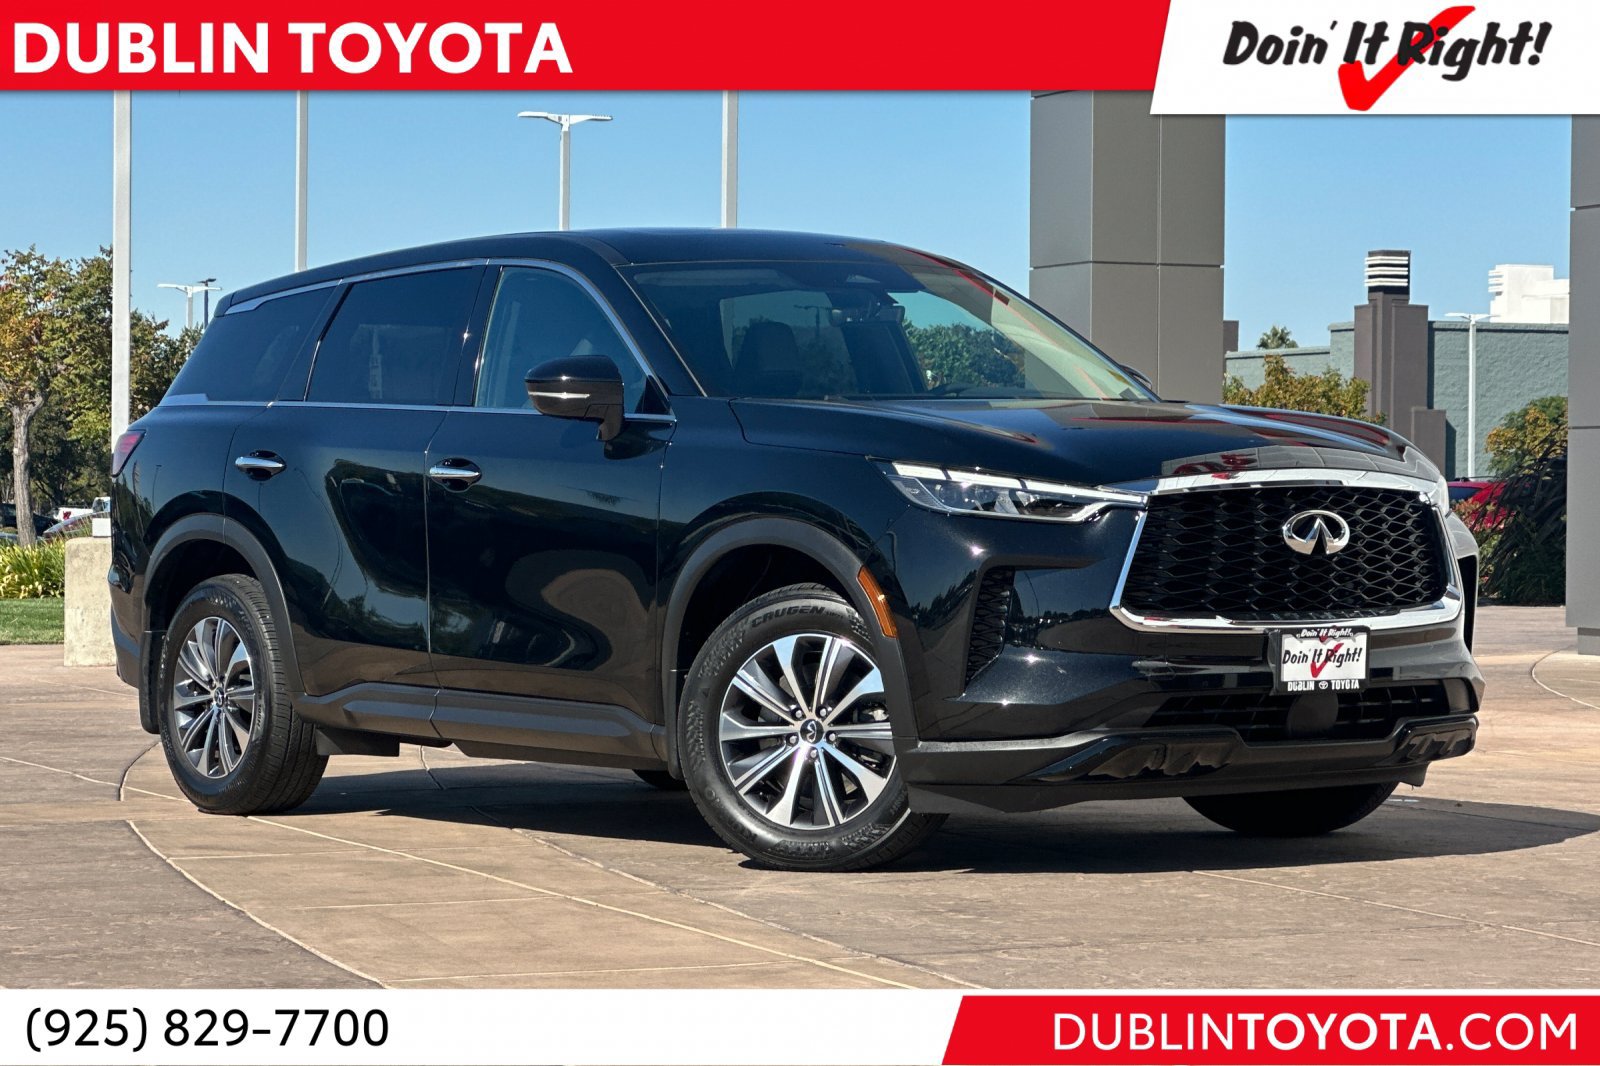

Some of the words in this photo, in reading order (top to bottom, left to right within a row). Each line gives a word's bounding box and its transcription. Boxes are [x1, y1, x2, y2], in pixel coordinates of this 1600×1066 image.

[751, 606, 825, 627] CRUGEN
[1313, 648, 1323, 663] It
[1326, 648, 1362, 668] Right!
[1288, 681, 1315, 691] DUBLIN
[1331, 680, 1360, 690] TOYOTA
